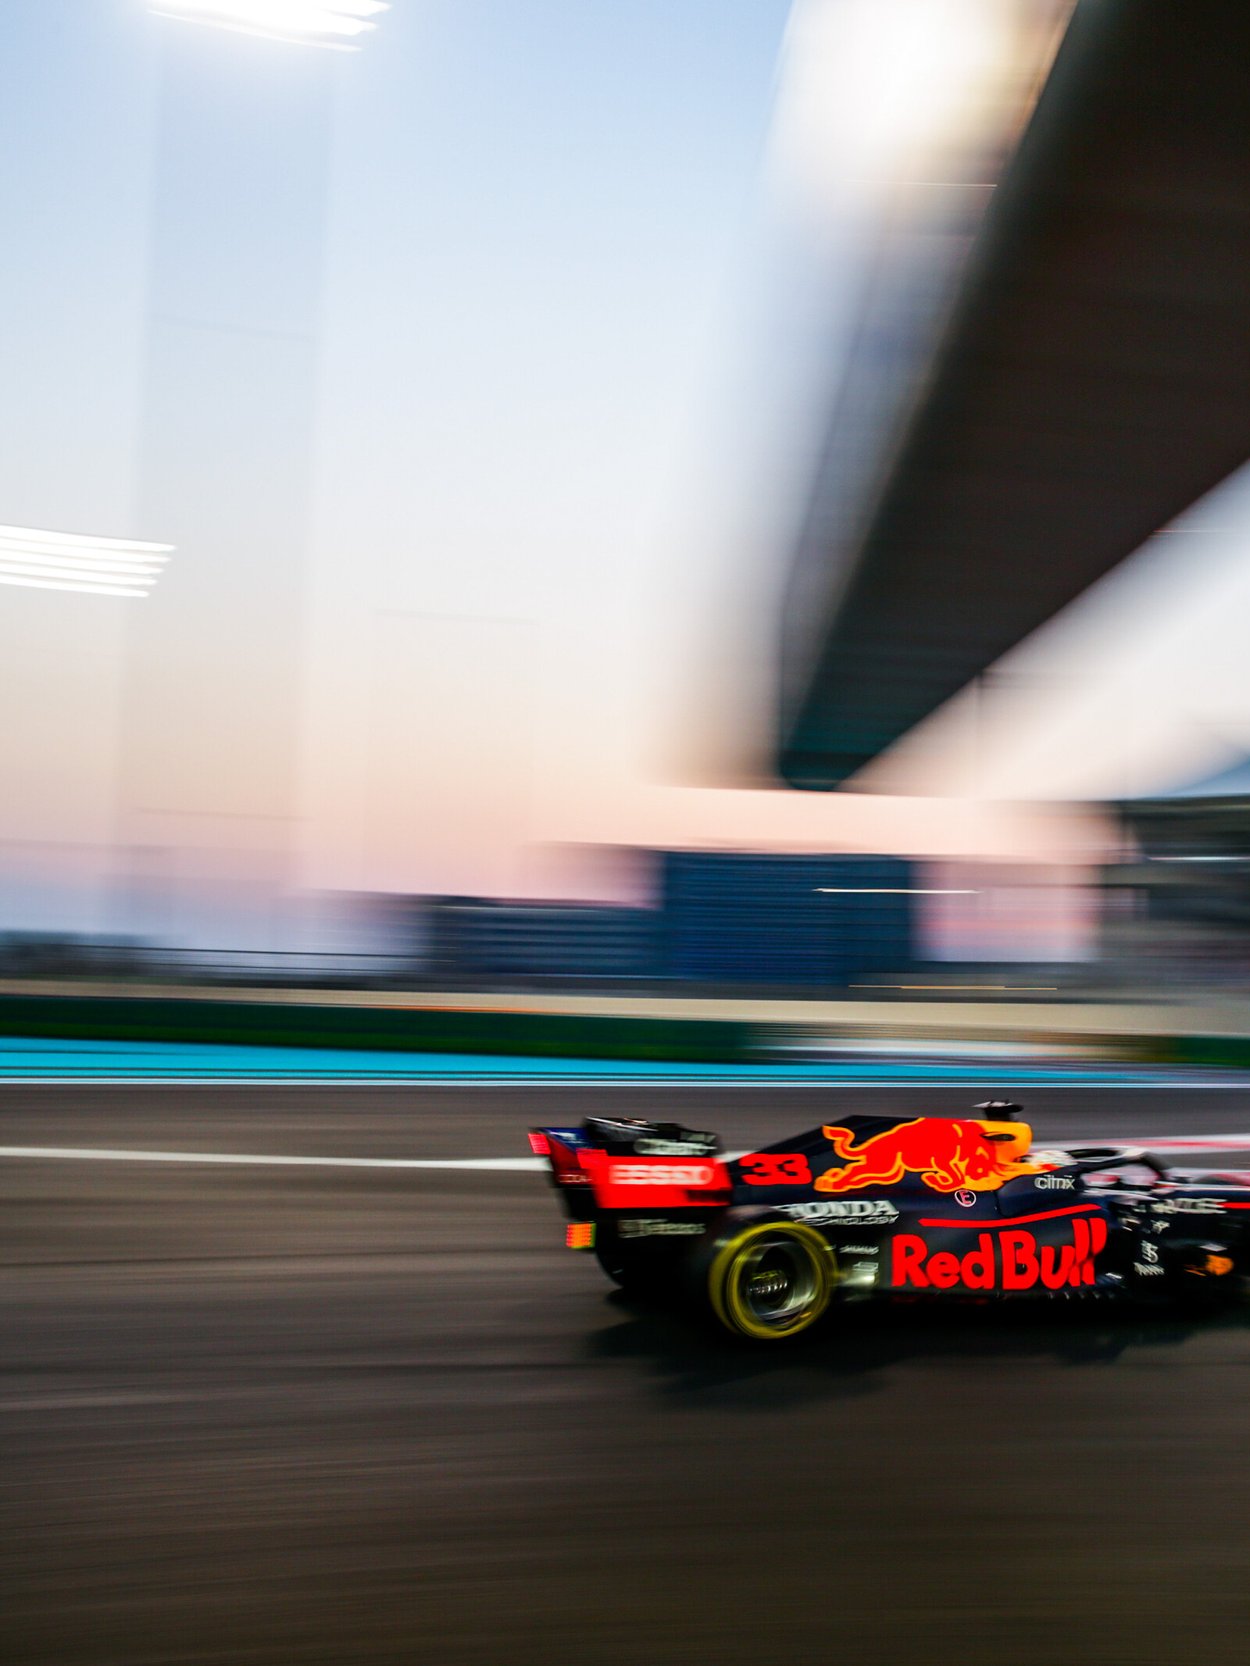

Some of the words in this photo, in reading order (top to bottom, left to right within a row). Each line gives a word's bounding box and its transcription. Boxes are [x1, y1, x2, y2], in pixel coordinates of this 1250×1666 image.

[738, 1153, 812, 1185] 33
[891, 1233, 996, 1289] Red
[998, 1218, 1107, 1290] Bull
